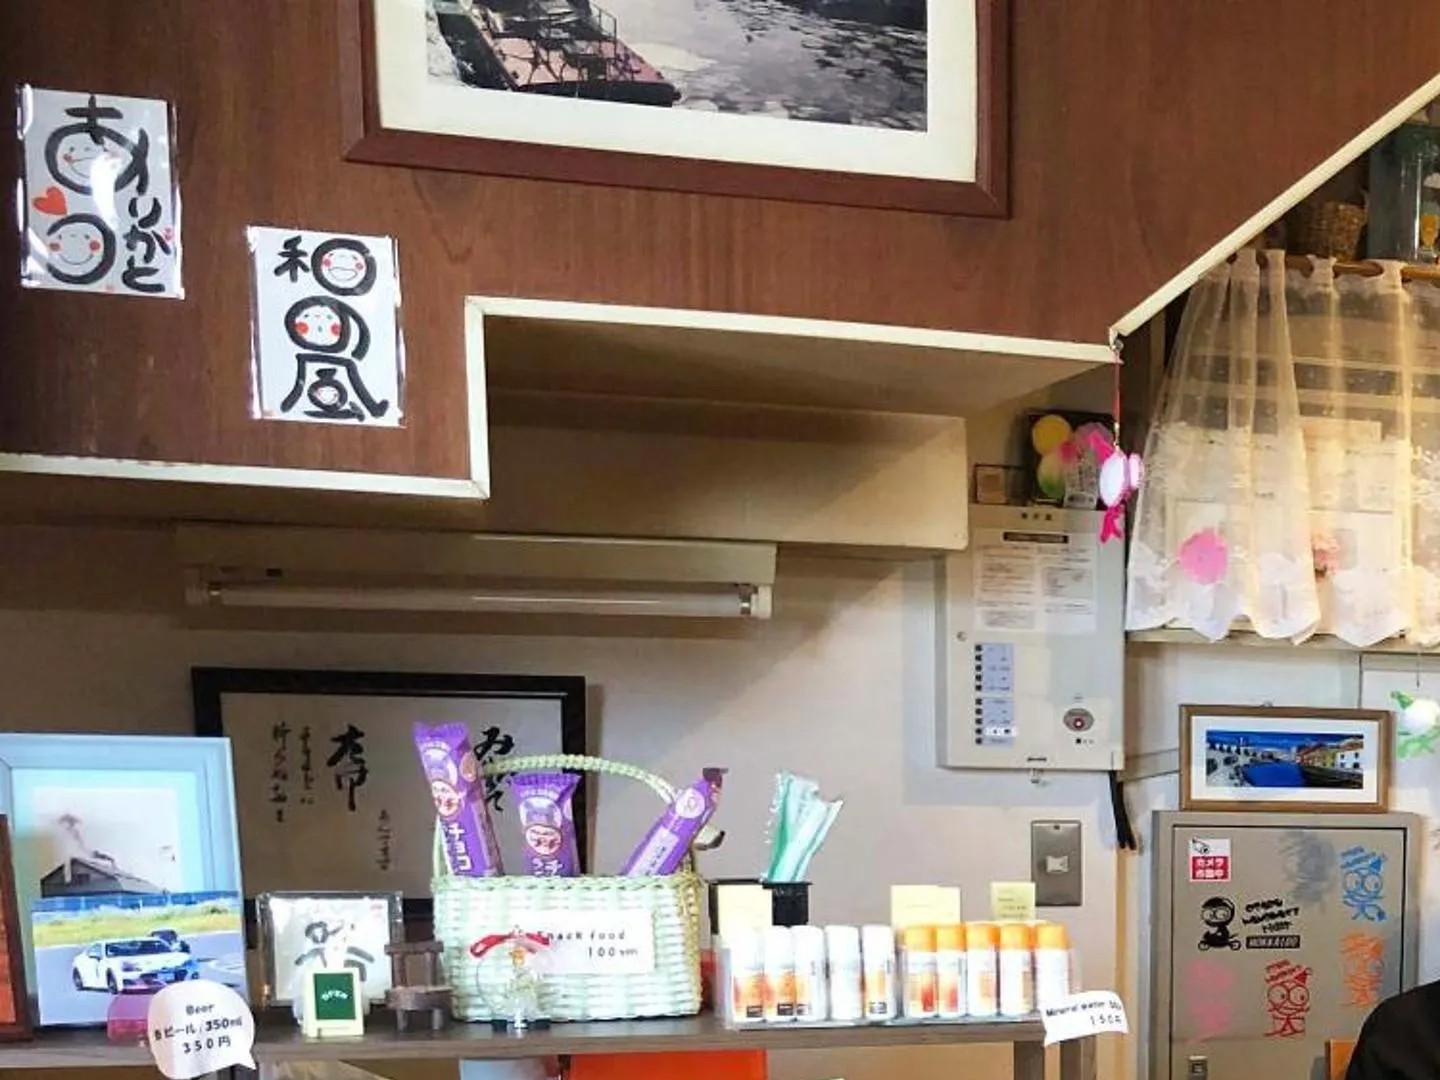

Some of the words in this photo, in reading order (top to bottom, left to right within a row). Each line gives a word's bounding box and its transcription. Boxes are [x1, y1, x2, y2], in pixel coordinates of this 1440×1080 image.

[273, 235, 389, 422] 和の風
[590, 930, 626, 941] food
[185, 1004, 215, 1015] Beer
[183, 1035, 231, 1054] 350円
